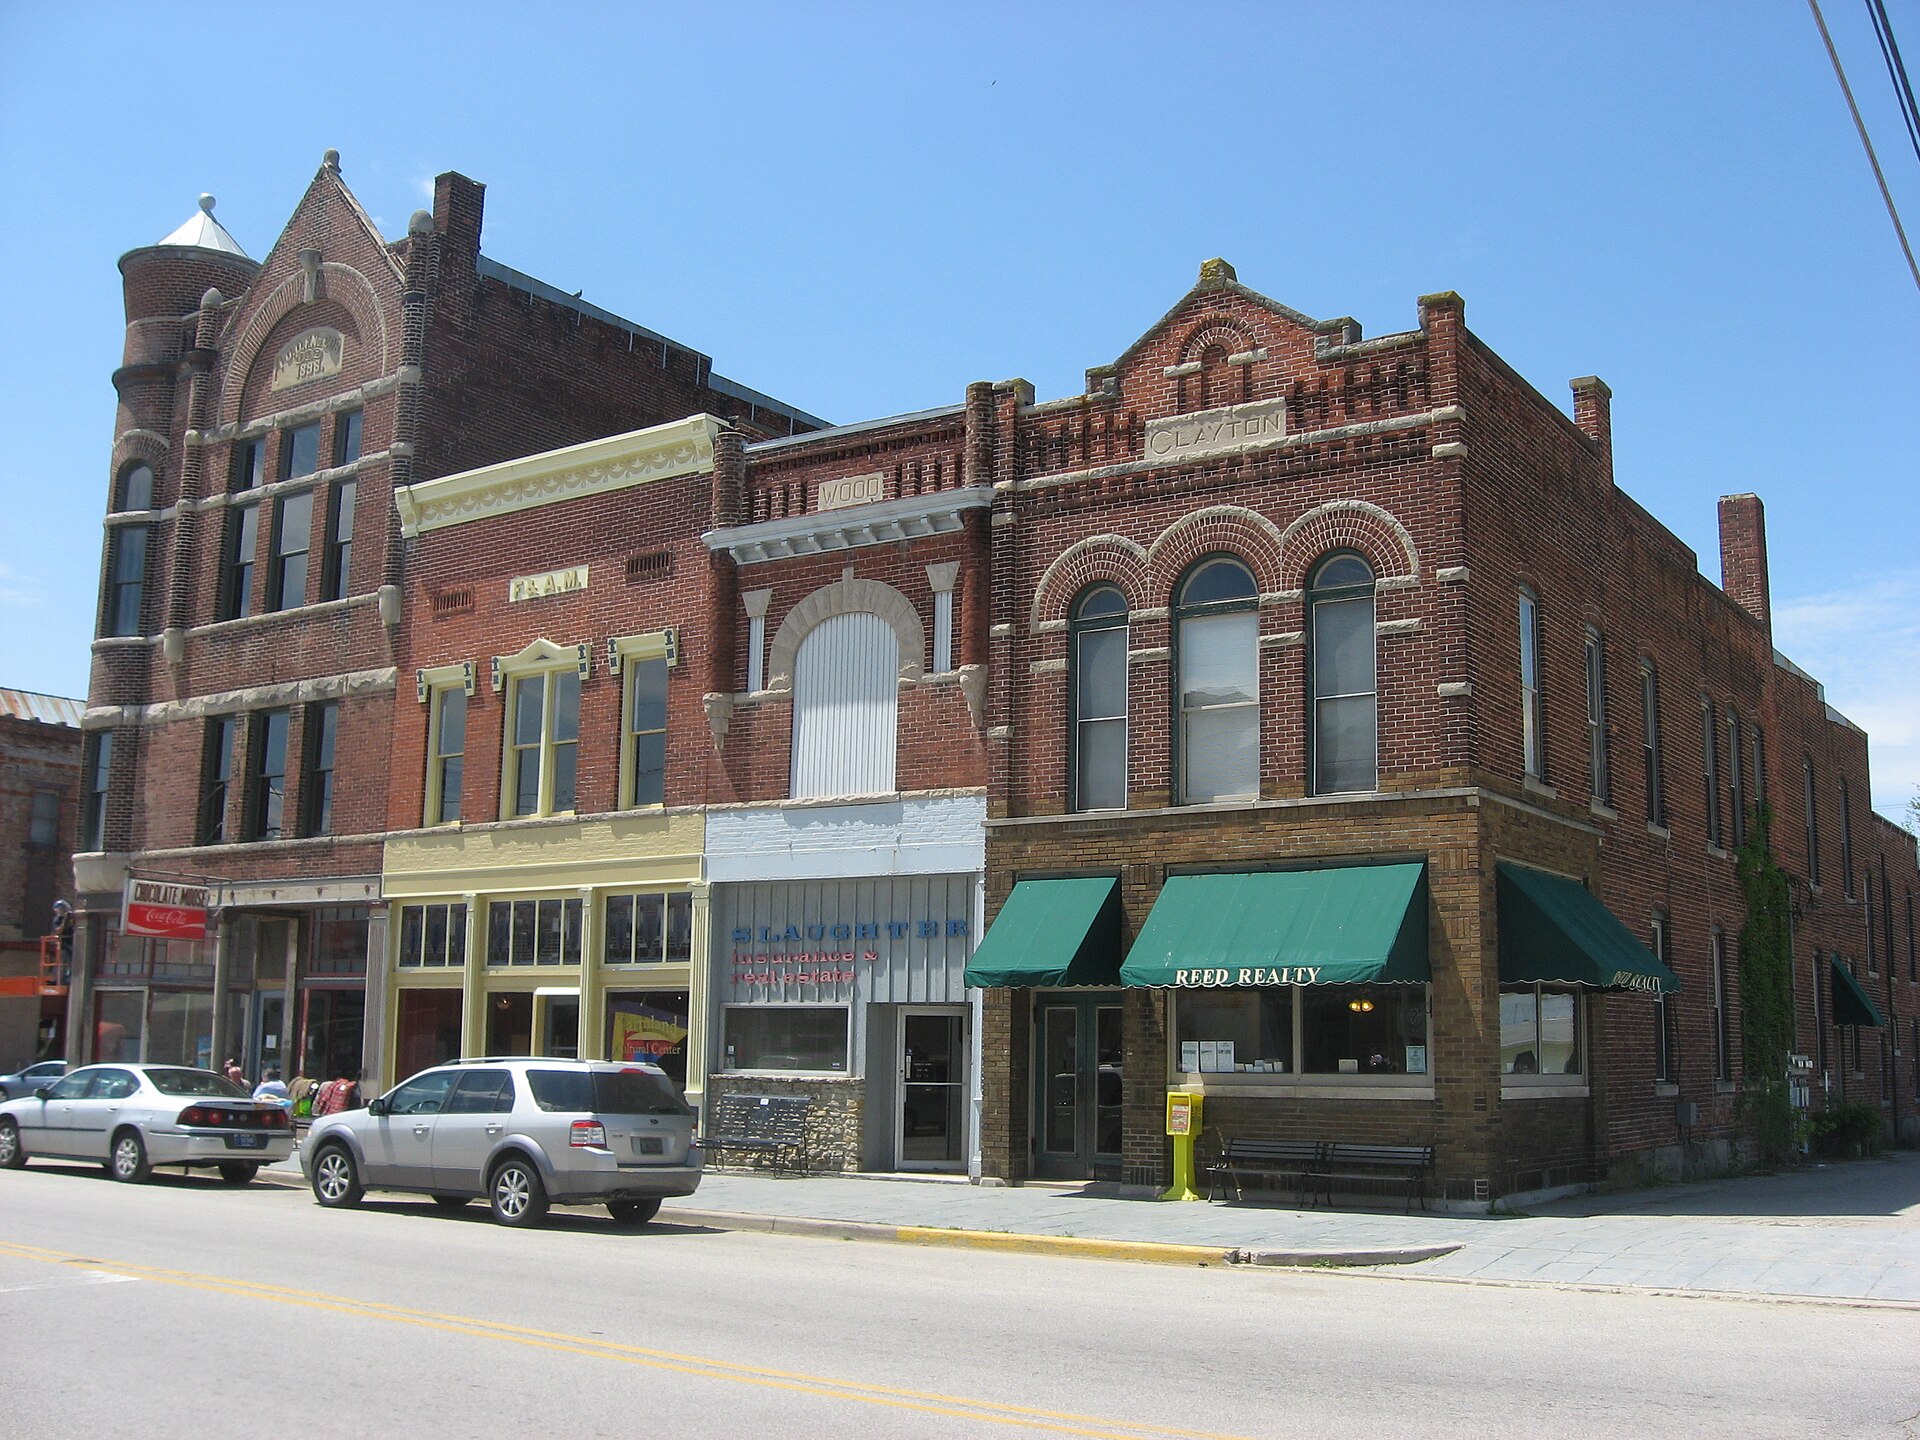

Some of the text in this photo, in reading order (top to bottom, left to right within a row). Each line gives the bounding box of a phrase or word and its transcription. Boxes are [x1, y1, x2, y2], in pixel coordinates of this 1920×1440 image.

[1151, 413, 1280, 455] CLAYTON
[822, 478, 879, 504] WOOD
[134, 883, 207, 907] CHOCOLATE MOOSE
[731, 919, 969, 943] SLAUGHTER
[862, 951, 878, 962] &
[731, 968, 856, 984] real estate
[1174, 967, 1322, 985] REED REALTY
[651, 1043, 681, 1056] Center
